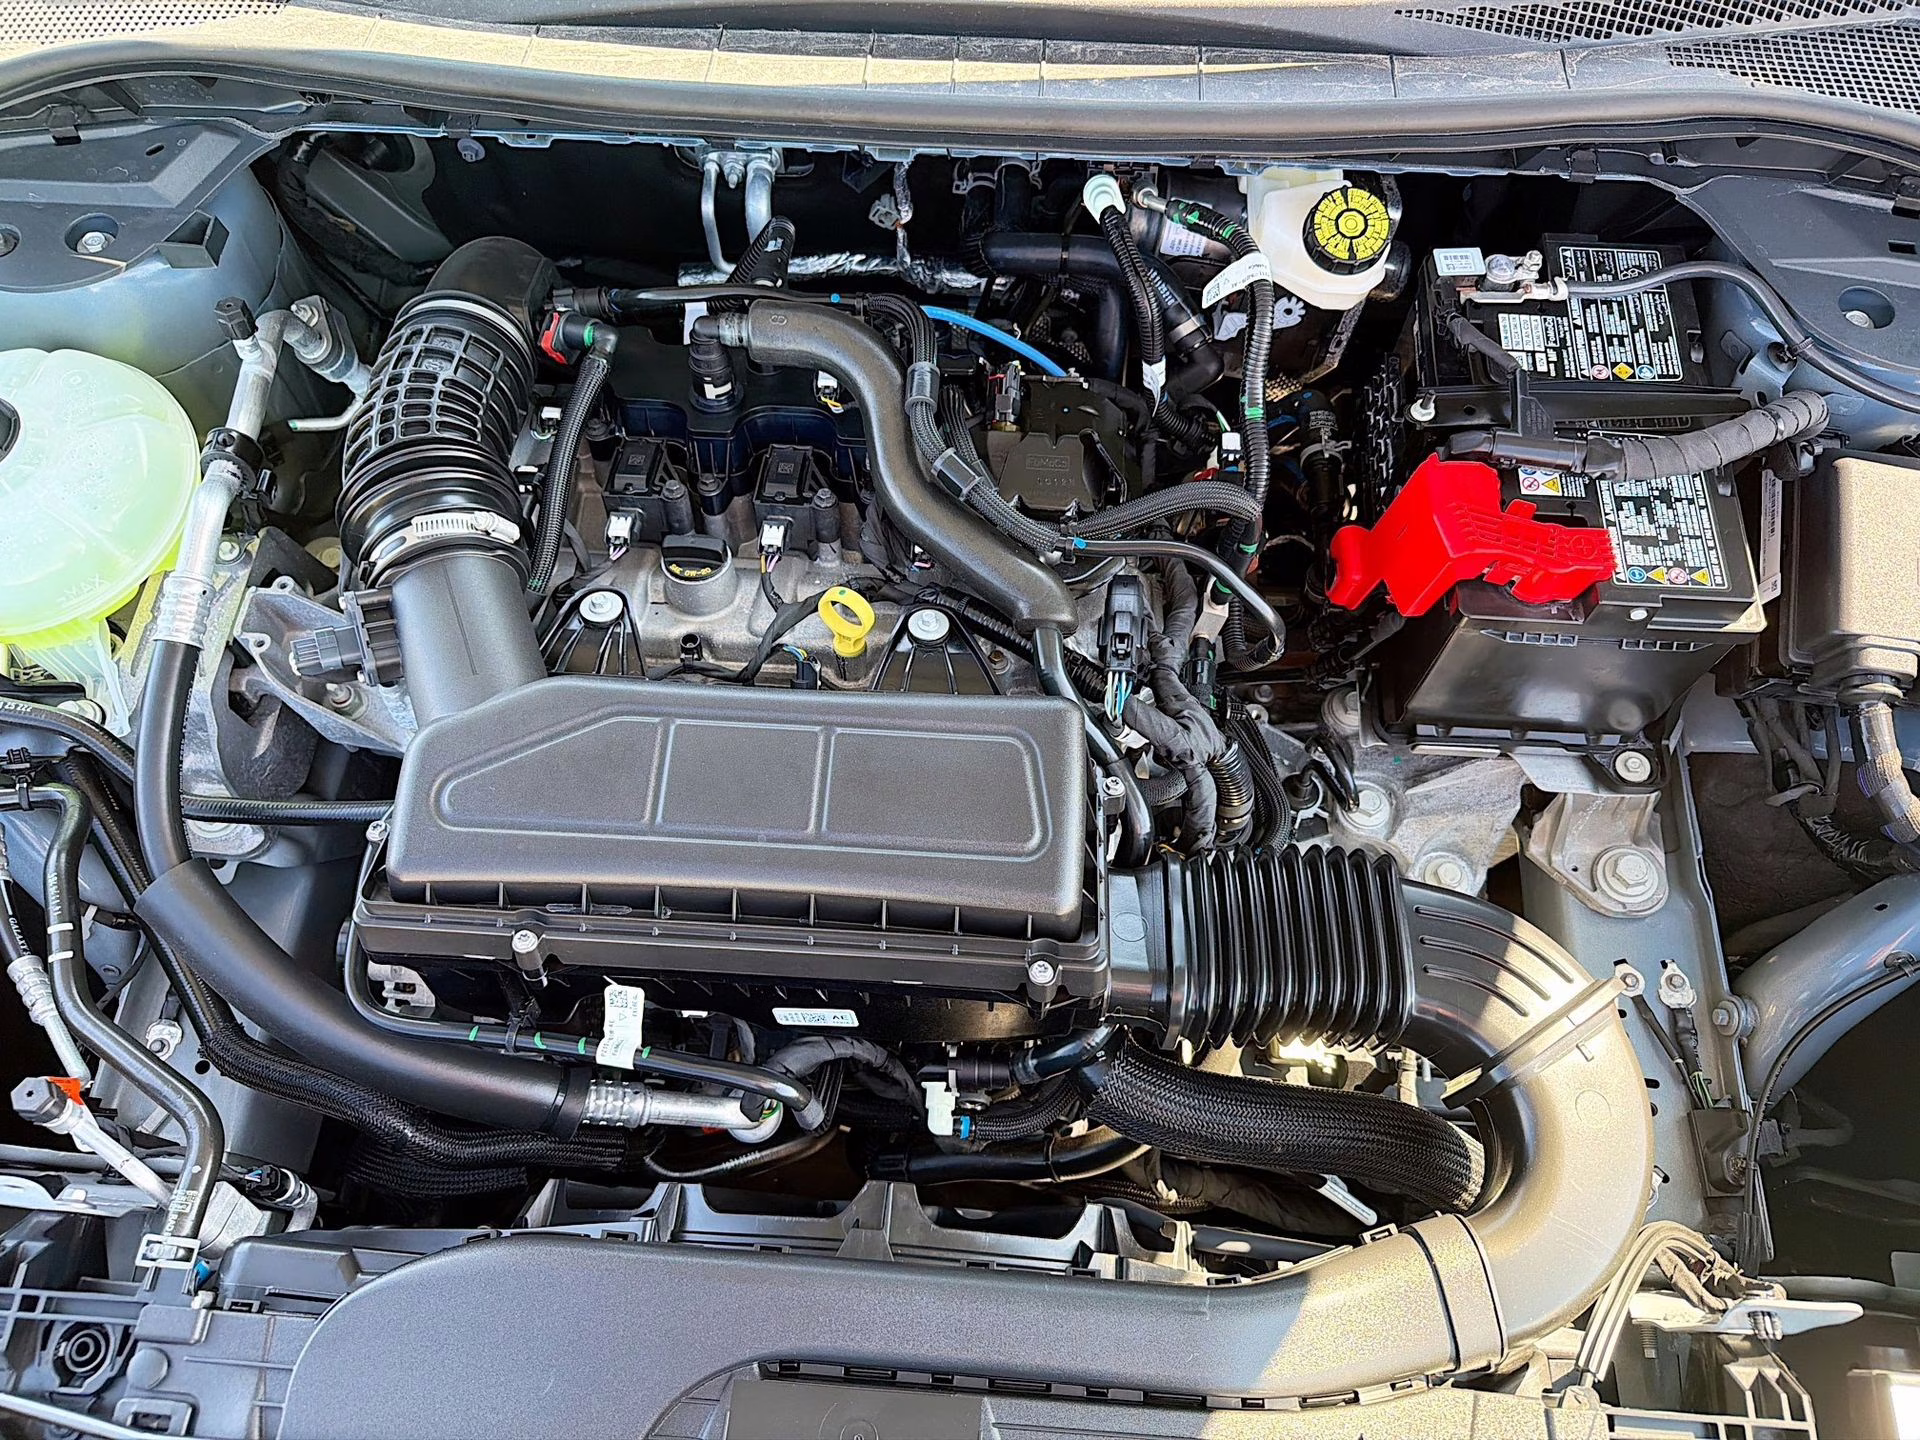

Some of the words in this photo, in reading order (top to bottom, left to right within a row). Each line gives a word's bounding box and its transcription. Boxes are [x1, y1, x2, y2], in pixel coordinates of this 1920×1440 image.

[1546, 318, 1555, 346] FoMoCo
[670, 564, 683, 574] SAE
[684, 567, 712, 576] 0W-20
[9, 917, 30, 951] GALAXY
